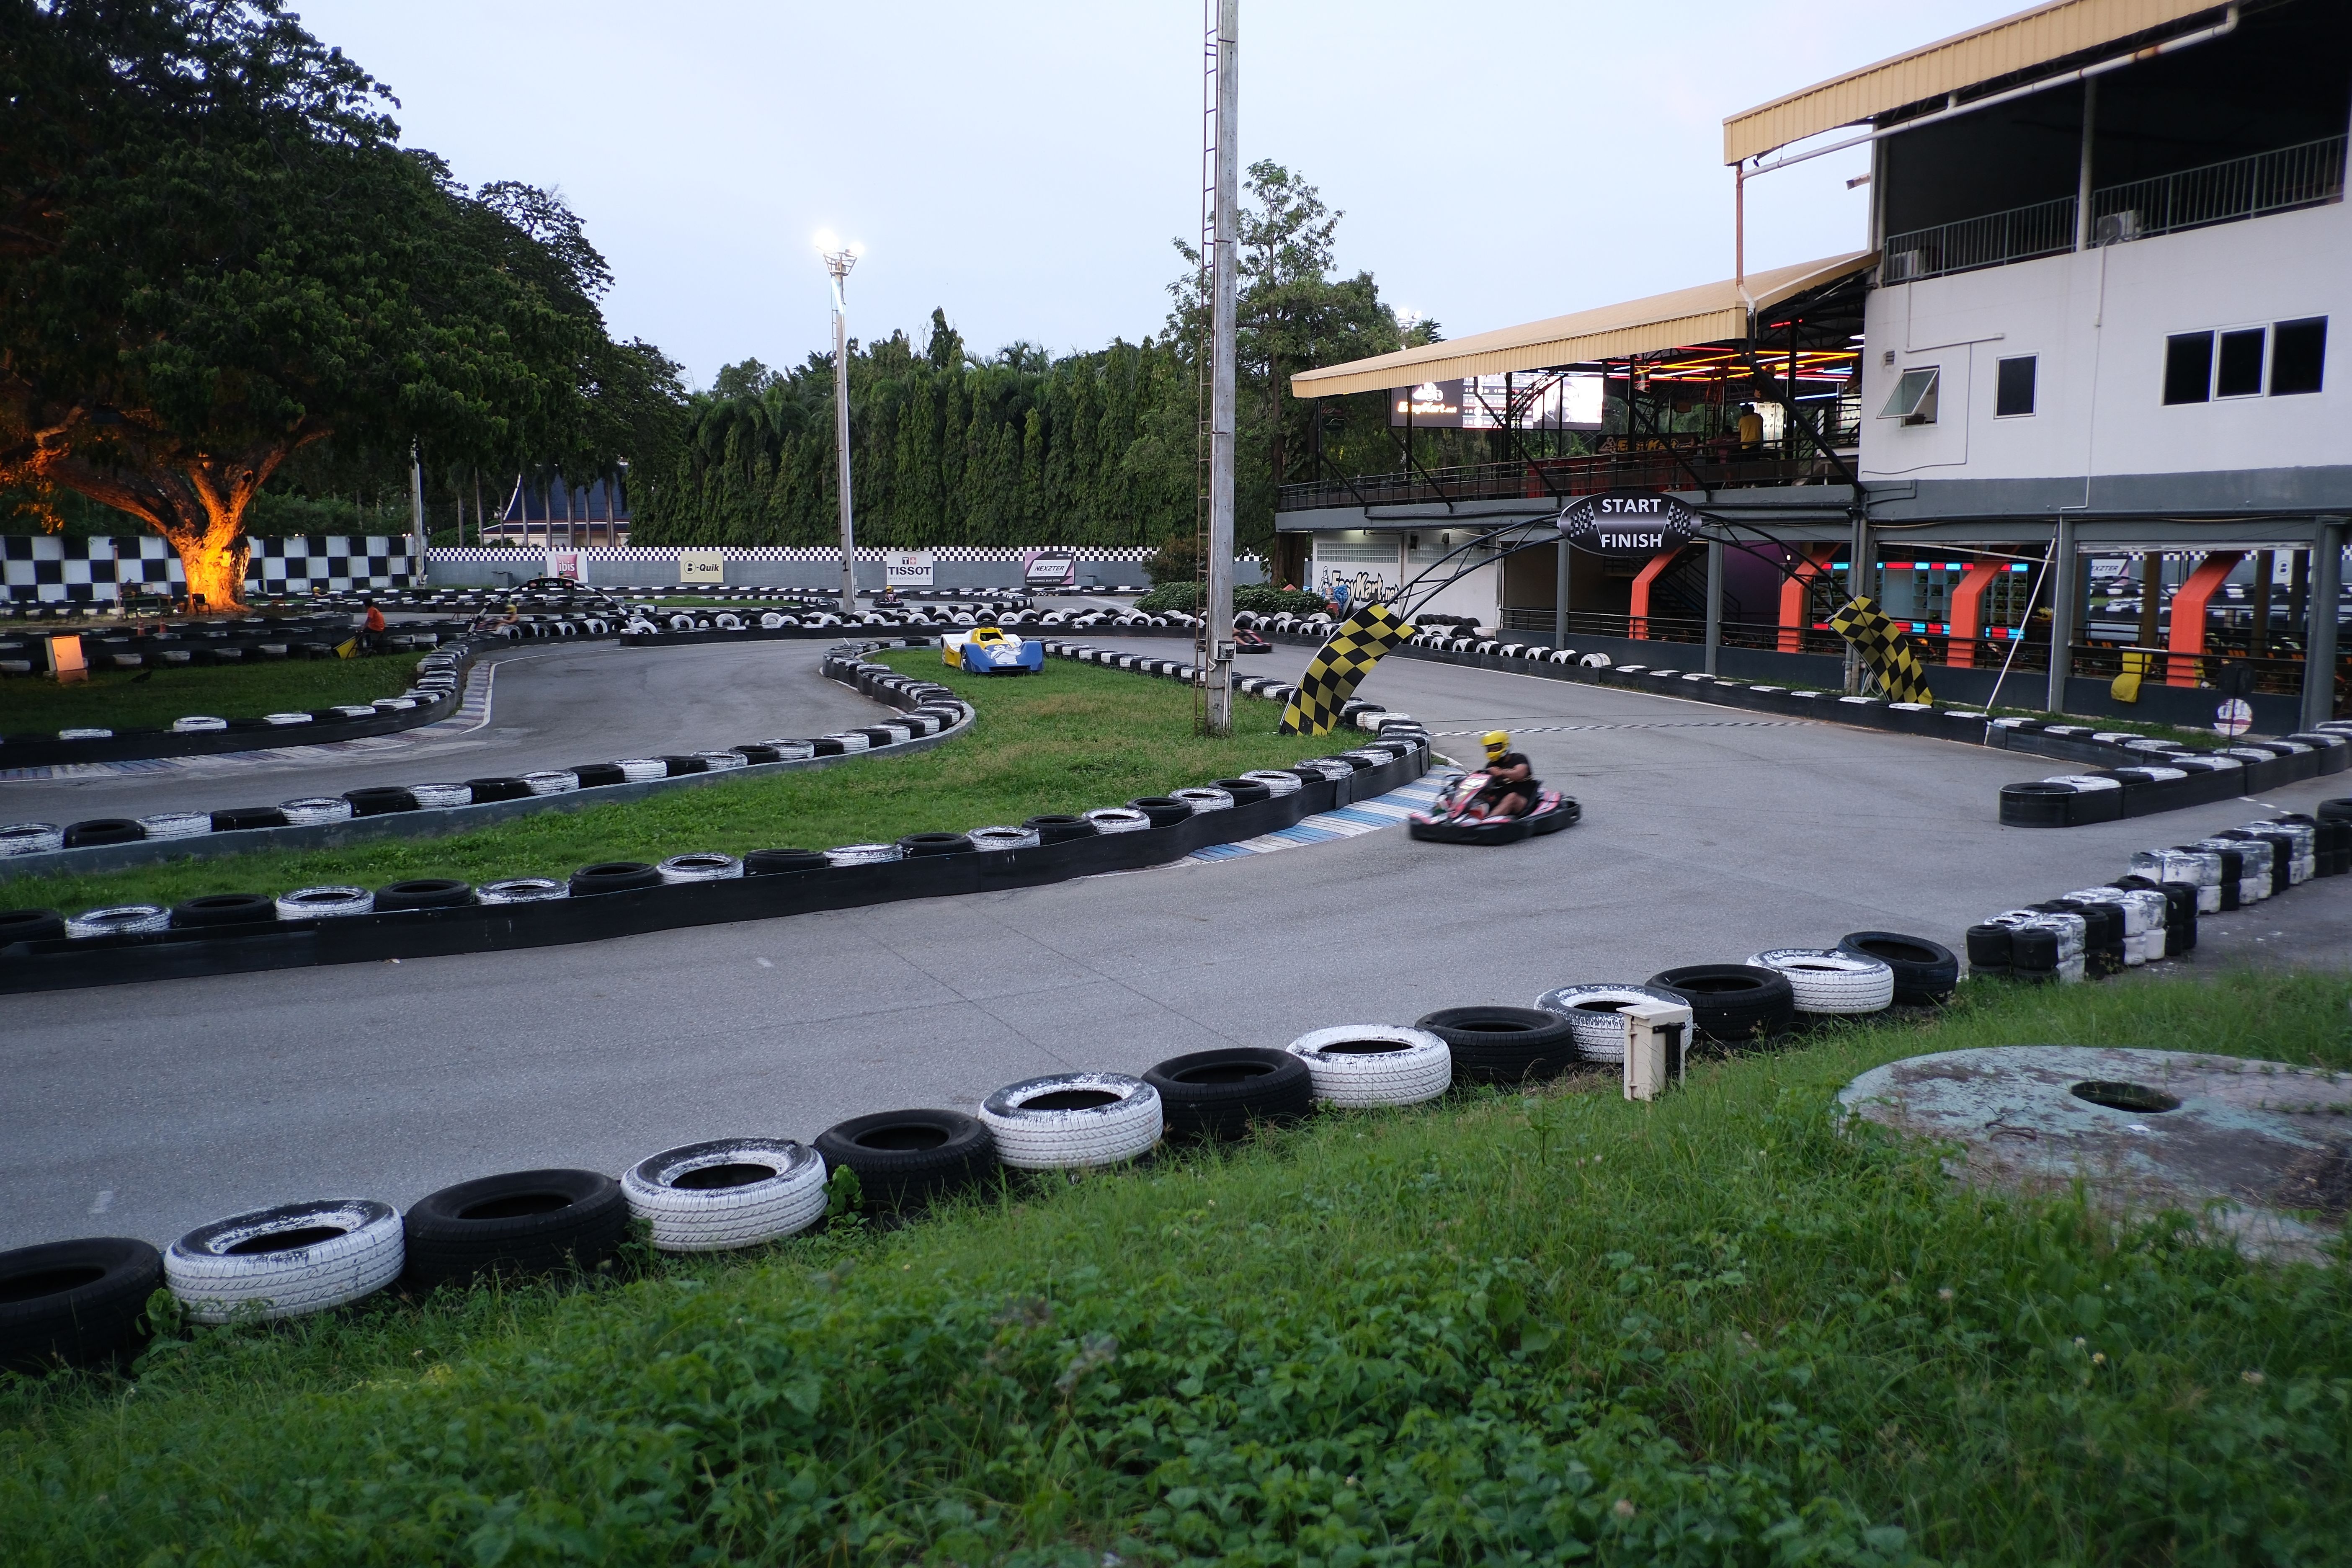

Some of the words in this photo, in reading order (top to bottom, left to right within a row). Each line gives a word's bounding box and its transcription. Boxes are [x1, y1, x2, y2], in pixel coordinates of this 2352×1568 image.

[1602, 499, 1661, 513] START
[1602, 534, 1661, 547] FINISH
[559, 561, 575, 571] ibis
[686, 563, 719, 572] B-Quik
[843, 560, 848, 572] 1
[887, 567, 931, 575] TISSOT
